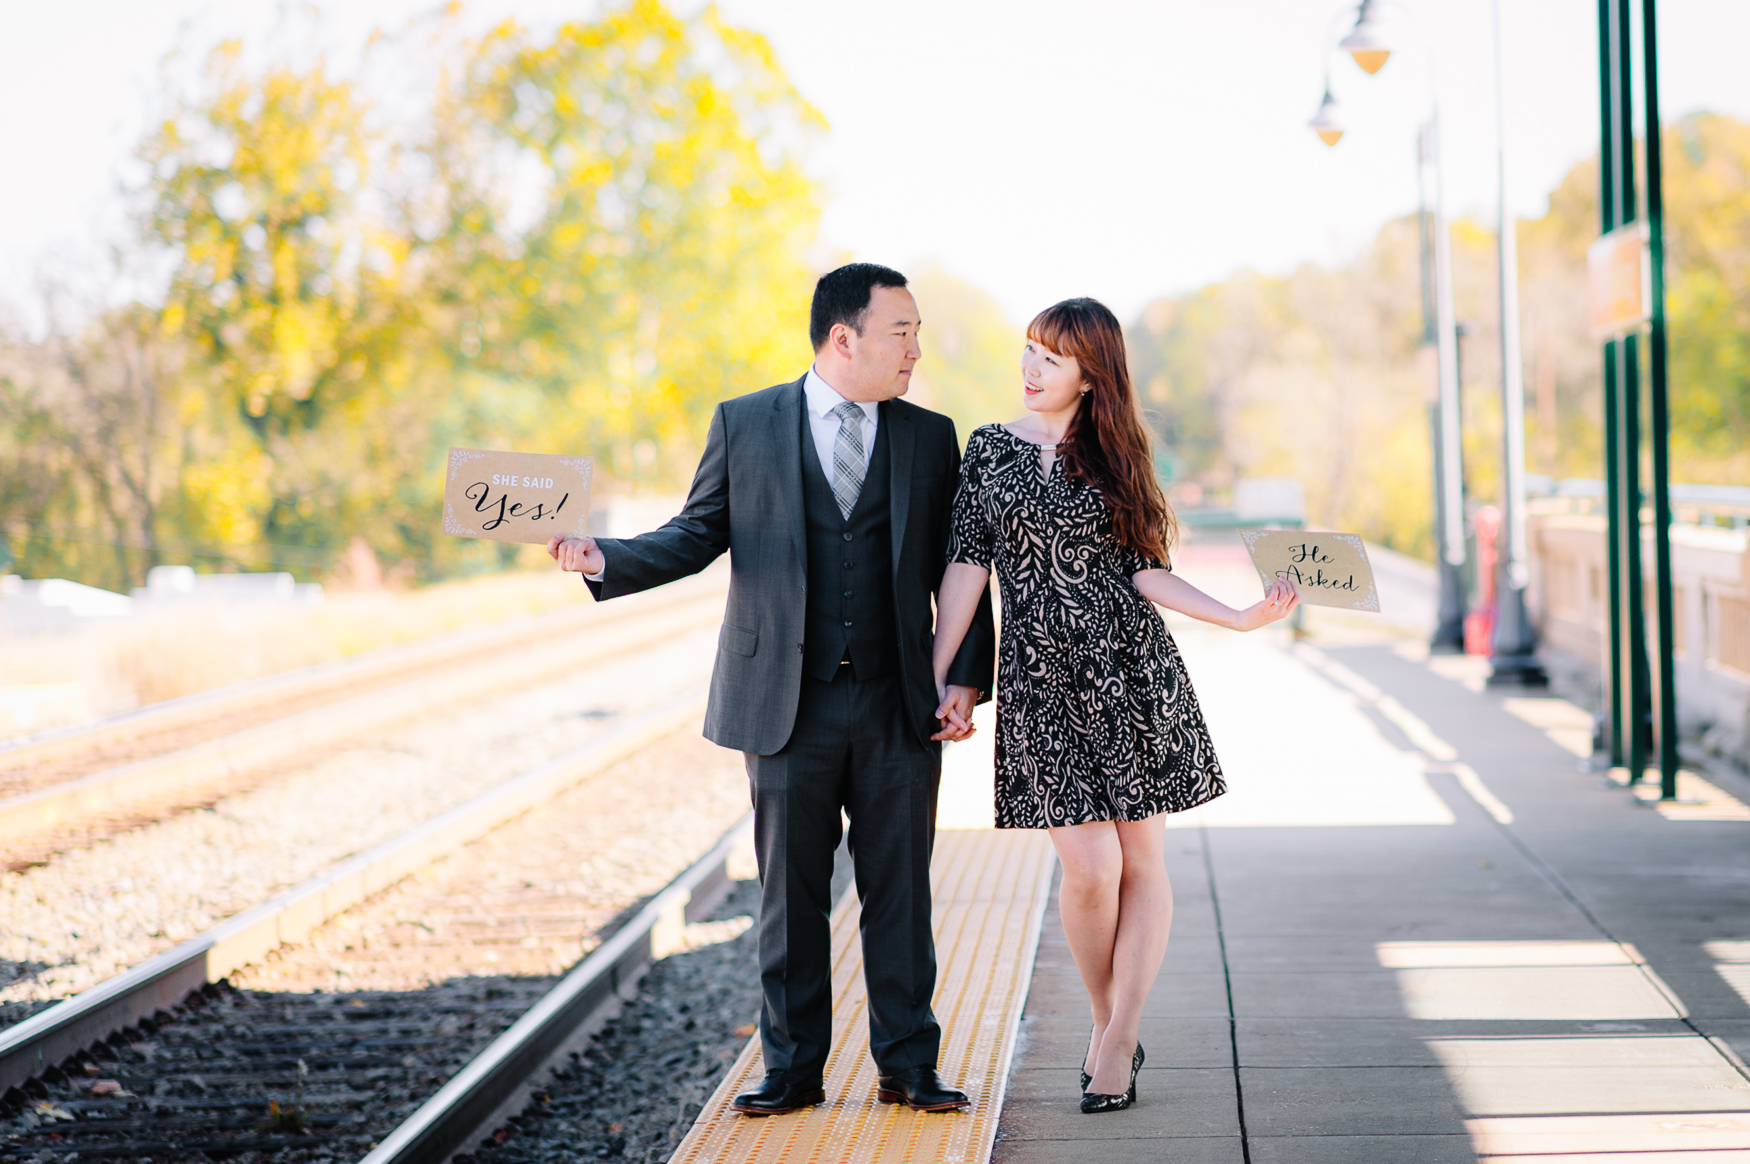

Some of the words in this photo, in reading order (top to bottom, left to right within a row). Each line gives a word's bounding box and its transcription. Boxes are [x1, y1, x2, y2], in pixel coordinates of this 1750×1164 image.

[491, 473, 519, 487] SHE
[522, 476, 554, 490] SAID
[464, 481, 570, 531] Yes!
[1288, 543, 1335, 564] He
[1275, 564, 1360, 592] Asked
